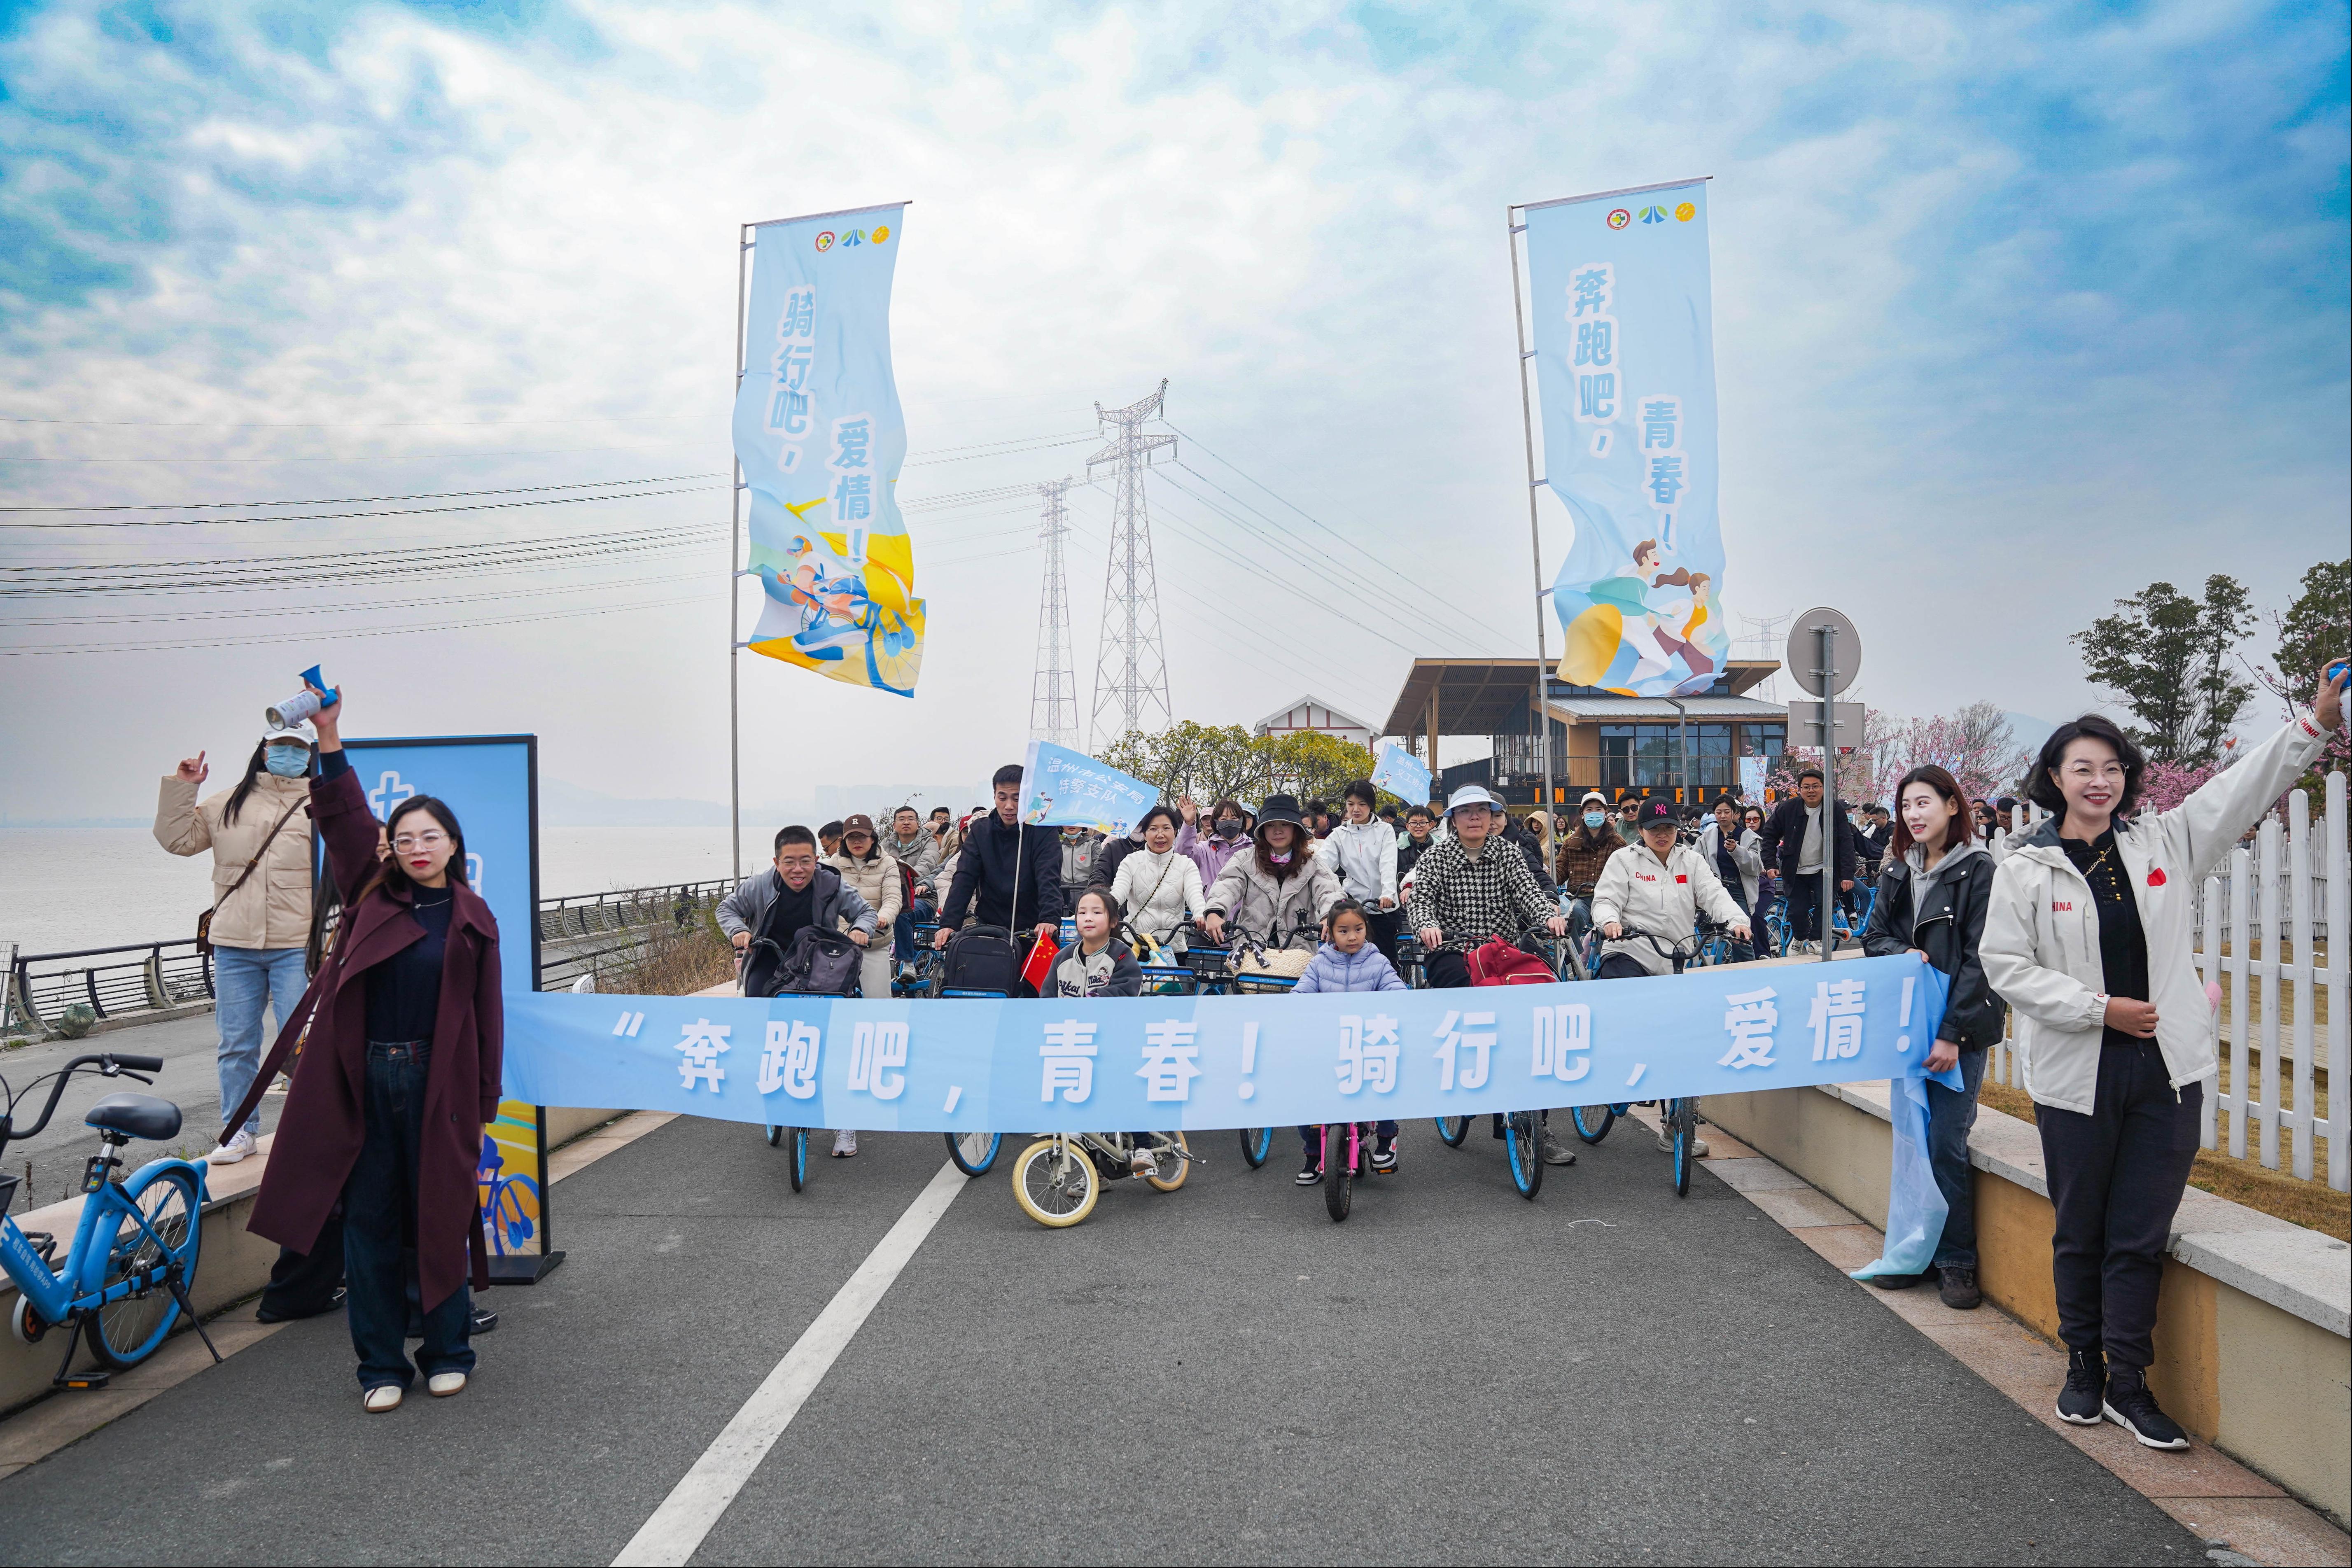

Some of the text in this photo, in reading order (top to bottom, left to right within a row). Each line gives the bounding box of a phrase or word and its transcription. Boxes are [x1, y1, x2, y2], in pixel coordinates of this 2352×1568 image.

[1573, 268, 1615, 451] 奔跑吧，
[770, 291, 814, 467] 骑行吧，
[832, 418, 871, 562] 爱情！
[1643, 401, 1683, 550] 青春！
[2300, 717, 2320, 738] CHINA
[1047, 757, 1146, 805] 温州市公安局
[1059, 777, 1118, 805] 特警支队
[1535, 787, 1565, 803] IN
[1654, 803, 1667, 815] NY
[1635, 872, 1656, 882] CHINA
